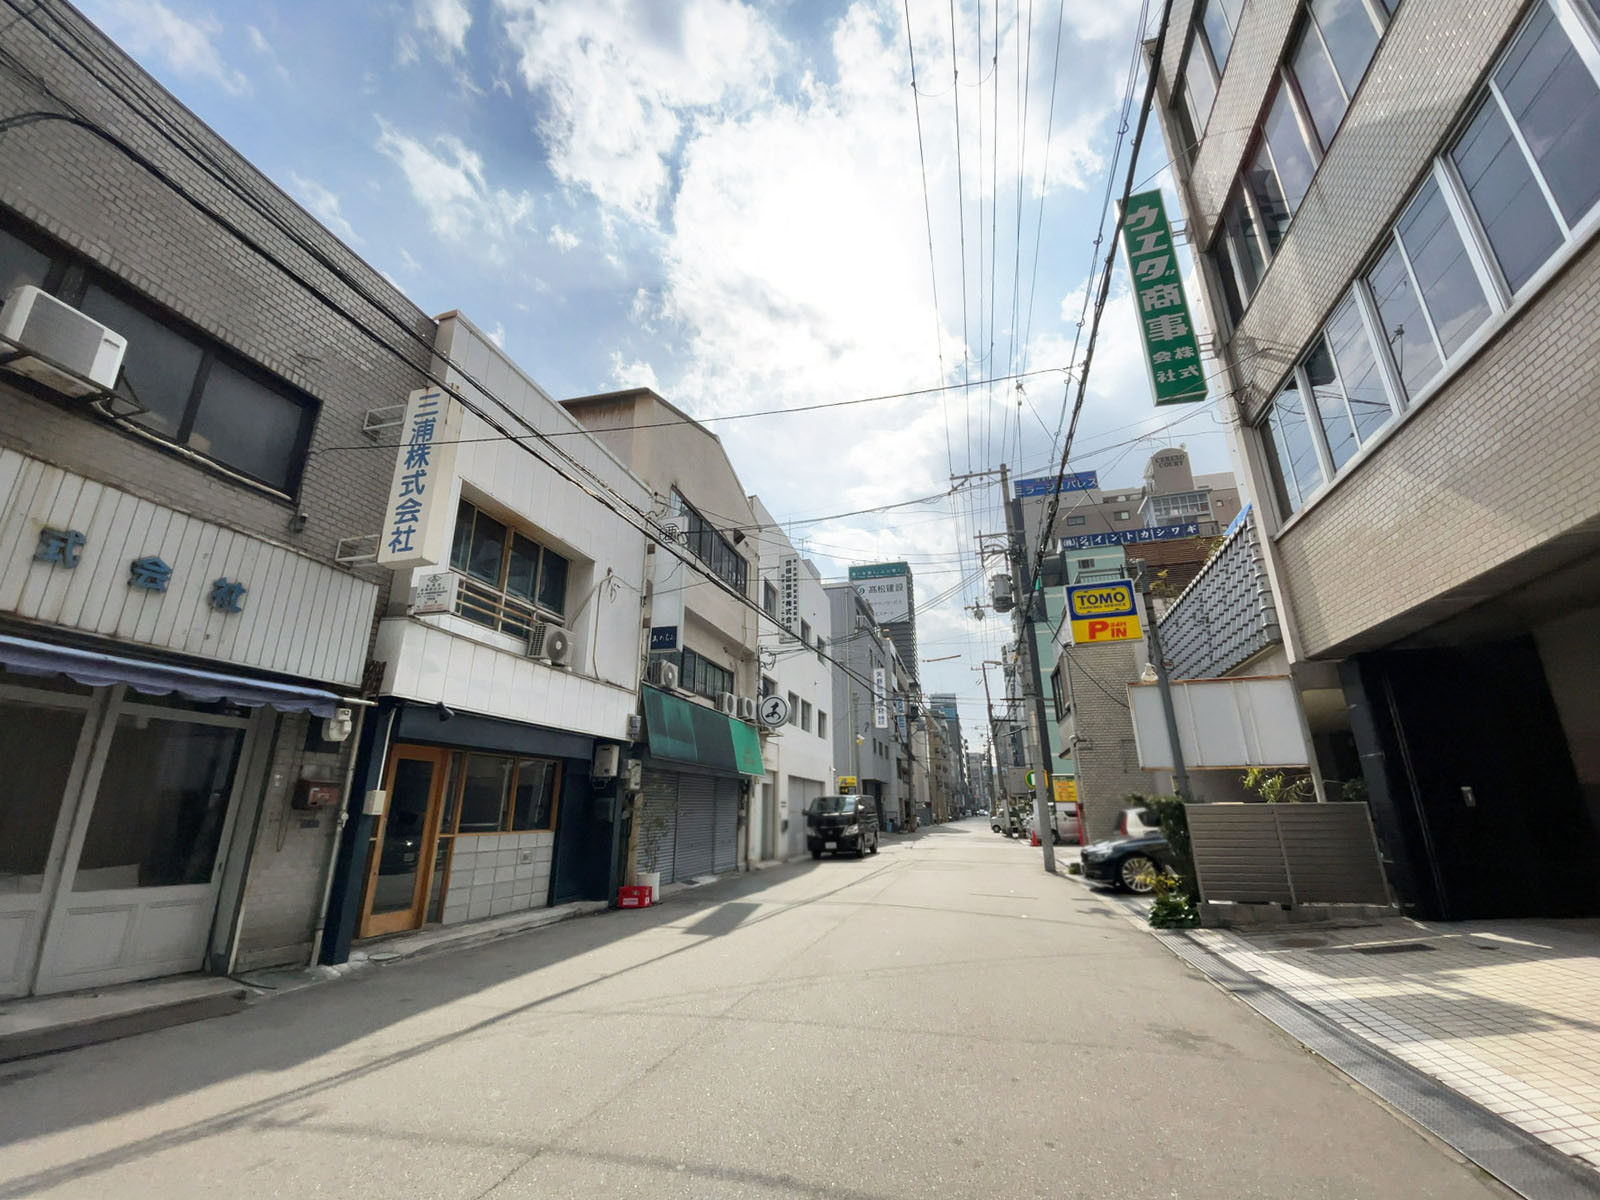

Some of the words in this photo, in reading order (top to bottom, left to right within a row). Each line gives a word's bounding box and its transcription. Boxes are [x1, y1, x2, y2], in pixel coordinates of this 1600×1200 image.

[388, 393, 441, 554] 三浦株式会社
[1077, 592, 1125, 606] TOMO
[1089, 620, 1109, 640] P
[1111, 628, 1127, 638] IN
